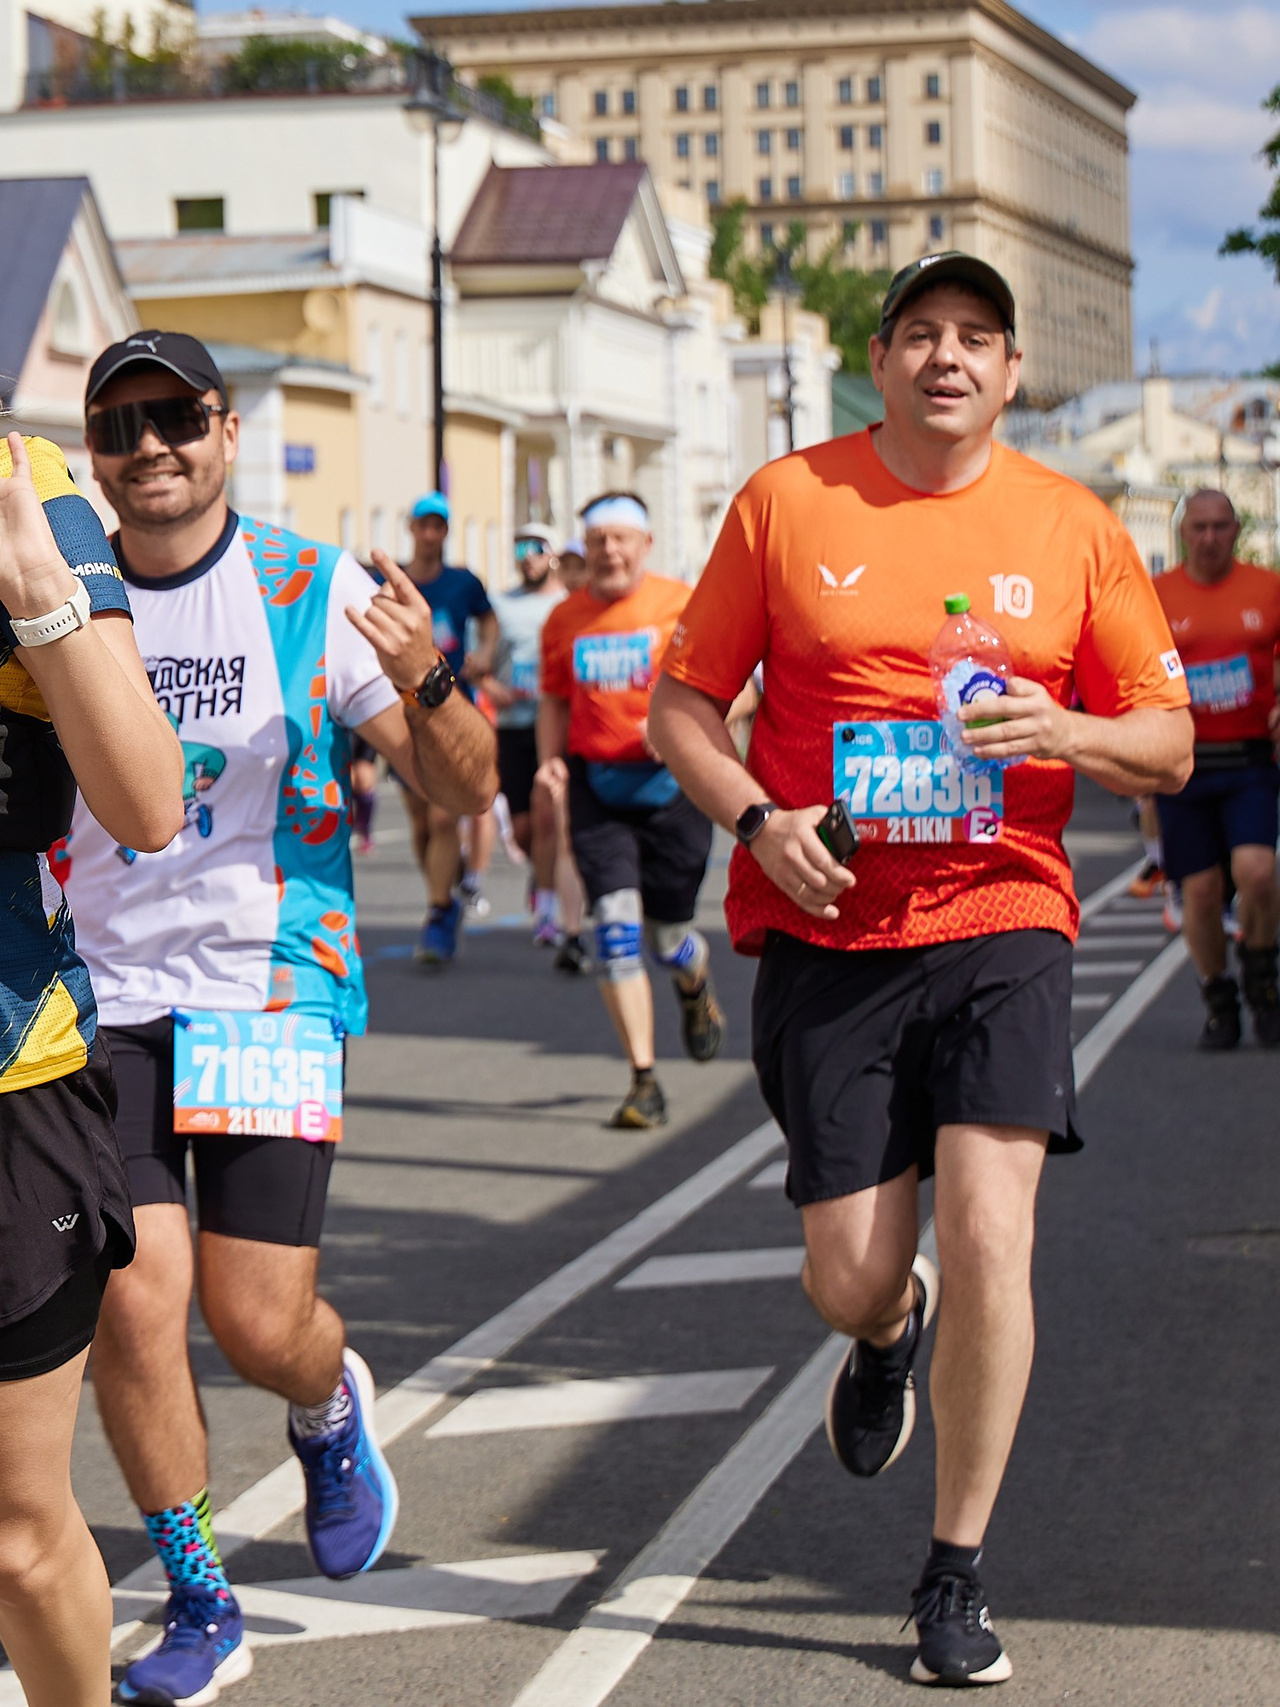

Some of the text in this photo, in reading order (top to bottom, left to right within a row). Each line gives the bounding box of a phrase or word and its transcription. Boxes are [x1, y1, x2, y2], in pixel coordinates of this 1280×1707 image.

[989, 573, 1033, 619] 10
[906, 725, 933, 751] 10
[887, 816, 952, 844] 21.1KM
[250, 1016, 277, 1043] 10
[192, 1044, 326, 1106] 71635
[226, 1106, 294, 1137] 21.1KM
[300, 1103, 324, 1136] E
